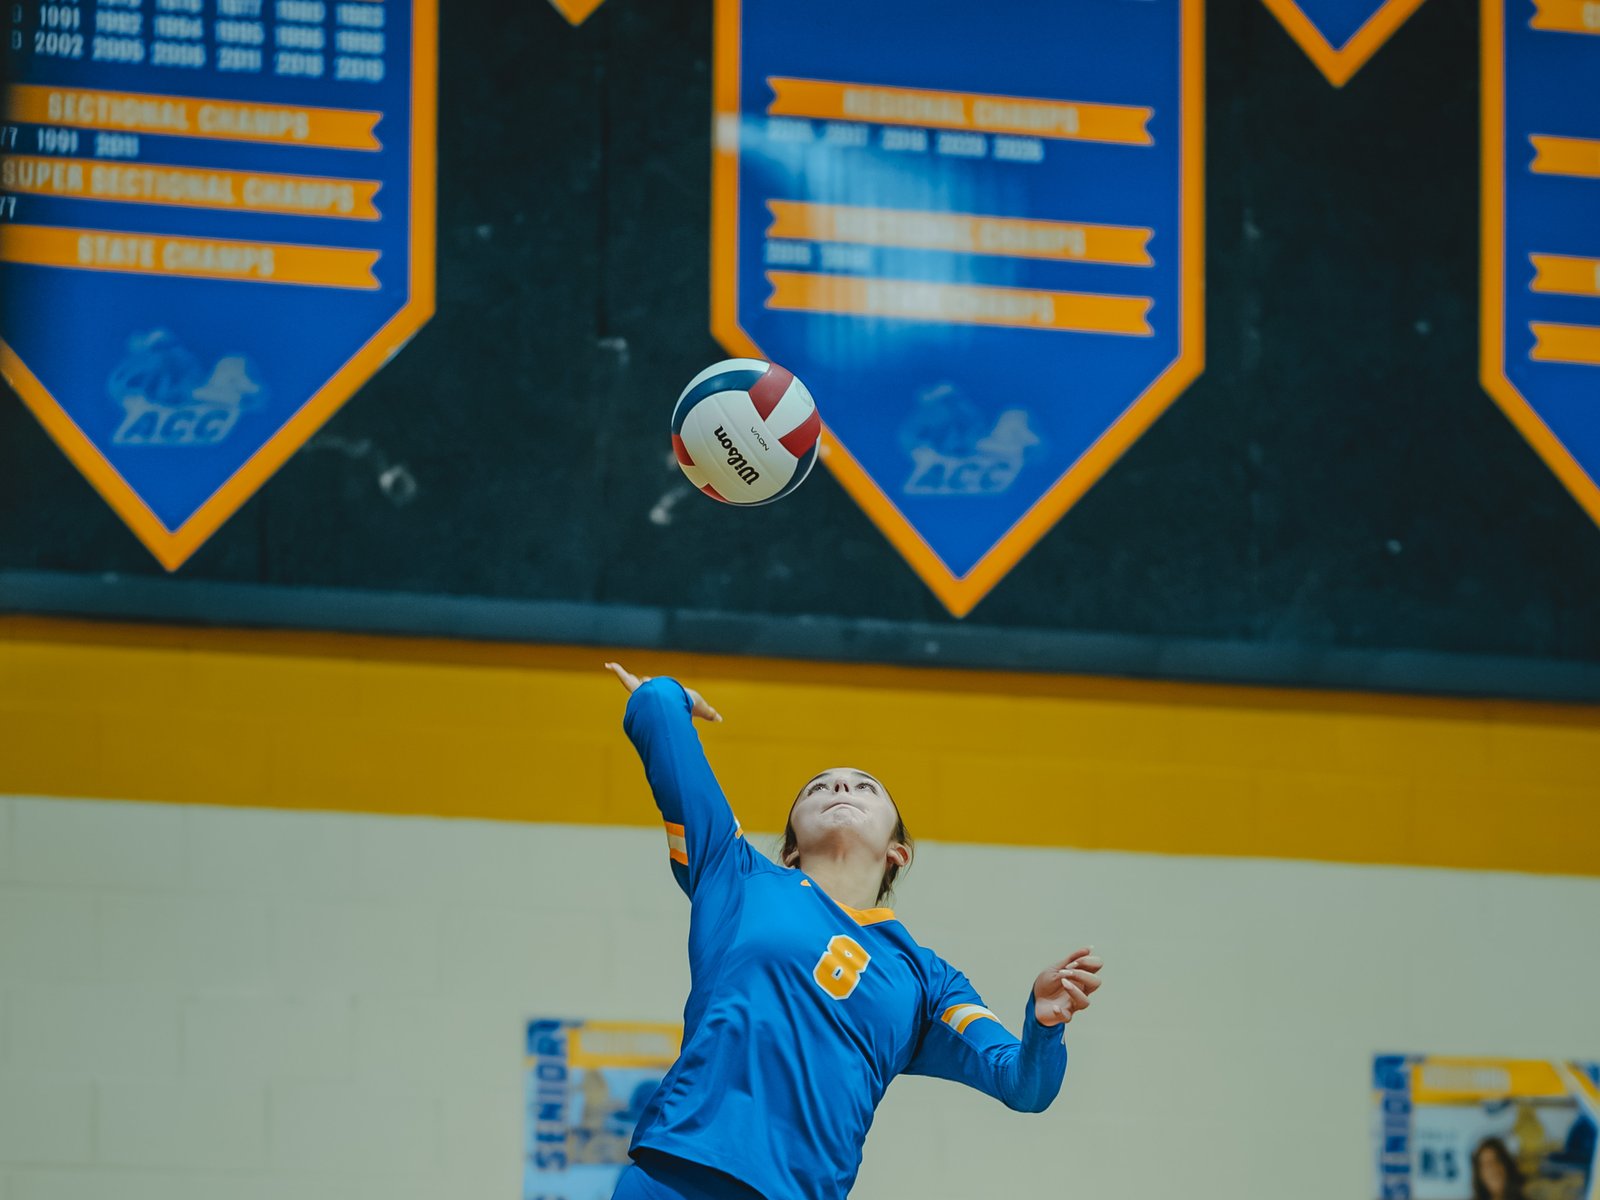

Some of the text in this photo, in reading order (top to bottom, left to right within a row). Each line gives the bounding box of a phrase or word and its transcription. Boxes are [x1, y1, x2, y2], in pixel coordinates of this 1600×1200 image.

[40, 5, 80, 30] 1991
[35, 31, 84, 60] 2002
[47, 92, 310, 140] SECTIONAL CHAMPS
[972, 100, 1080, 134] CHAMPS
[37, 127, 79, 154] 1991
[3, 160, 355, 214] SUPER SECTIONAL CHAMPS
[78, 234, 276, 278] STATE CHAMPS
[121, 408, 232, 442] ACC
[750, 426, 770, 451] NOVA
[713, 424, 760, 486] Wilson
[813, 934, 872, 1001] 8
[535, 1031, 569, 1173] SENIOR
